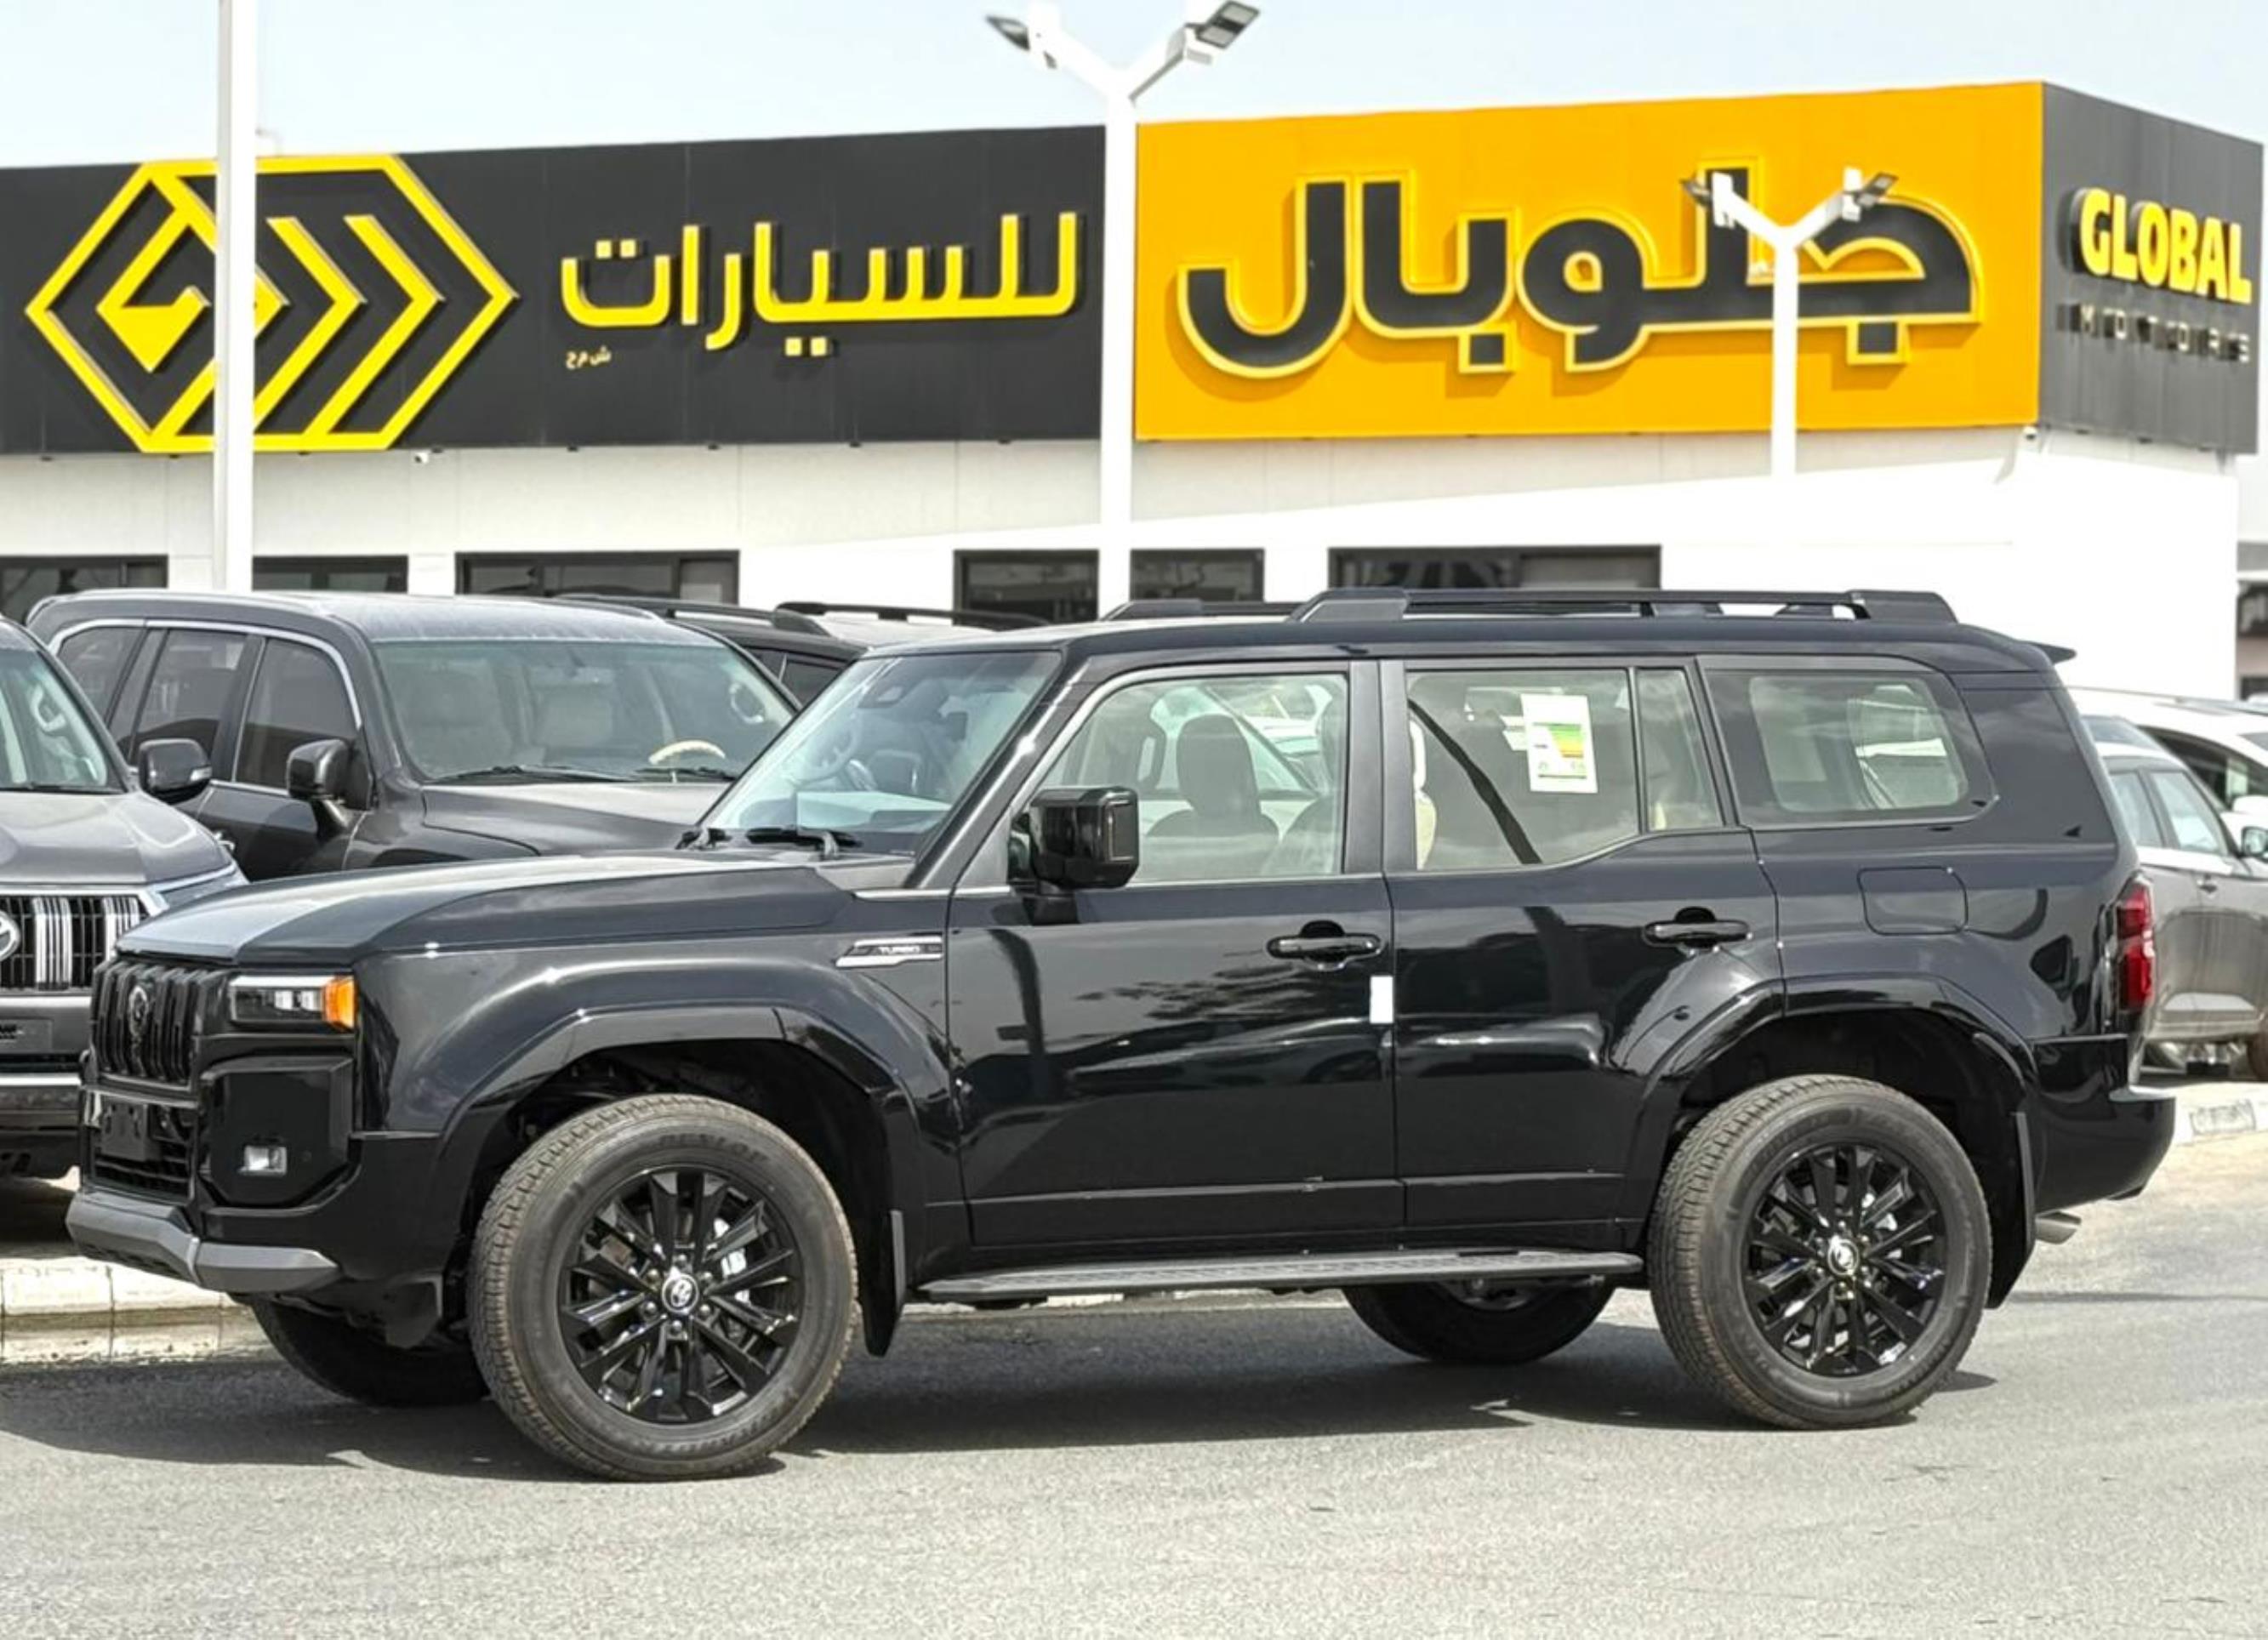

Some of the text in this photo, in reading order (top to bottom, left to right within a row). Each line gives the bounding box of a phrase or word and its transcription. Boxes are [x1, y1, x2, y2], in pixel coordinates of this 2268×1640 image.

[561, 212, 1078, 356] للسيارات
[1179, 157, 1983, 379] جلوبال
[2074, 186, 2253, 305] GLOBAL
